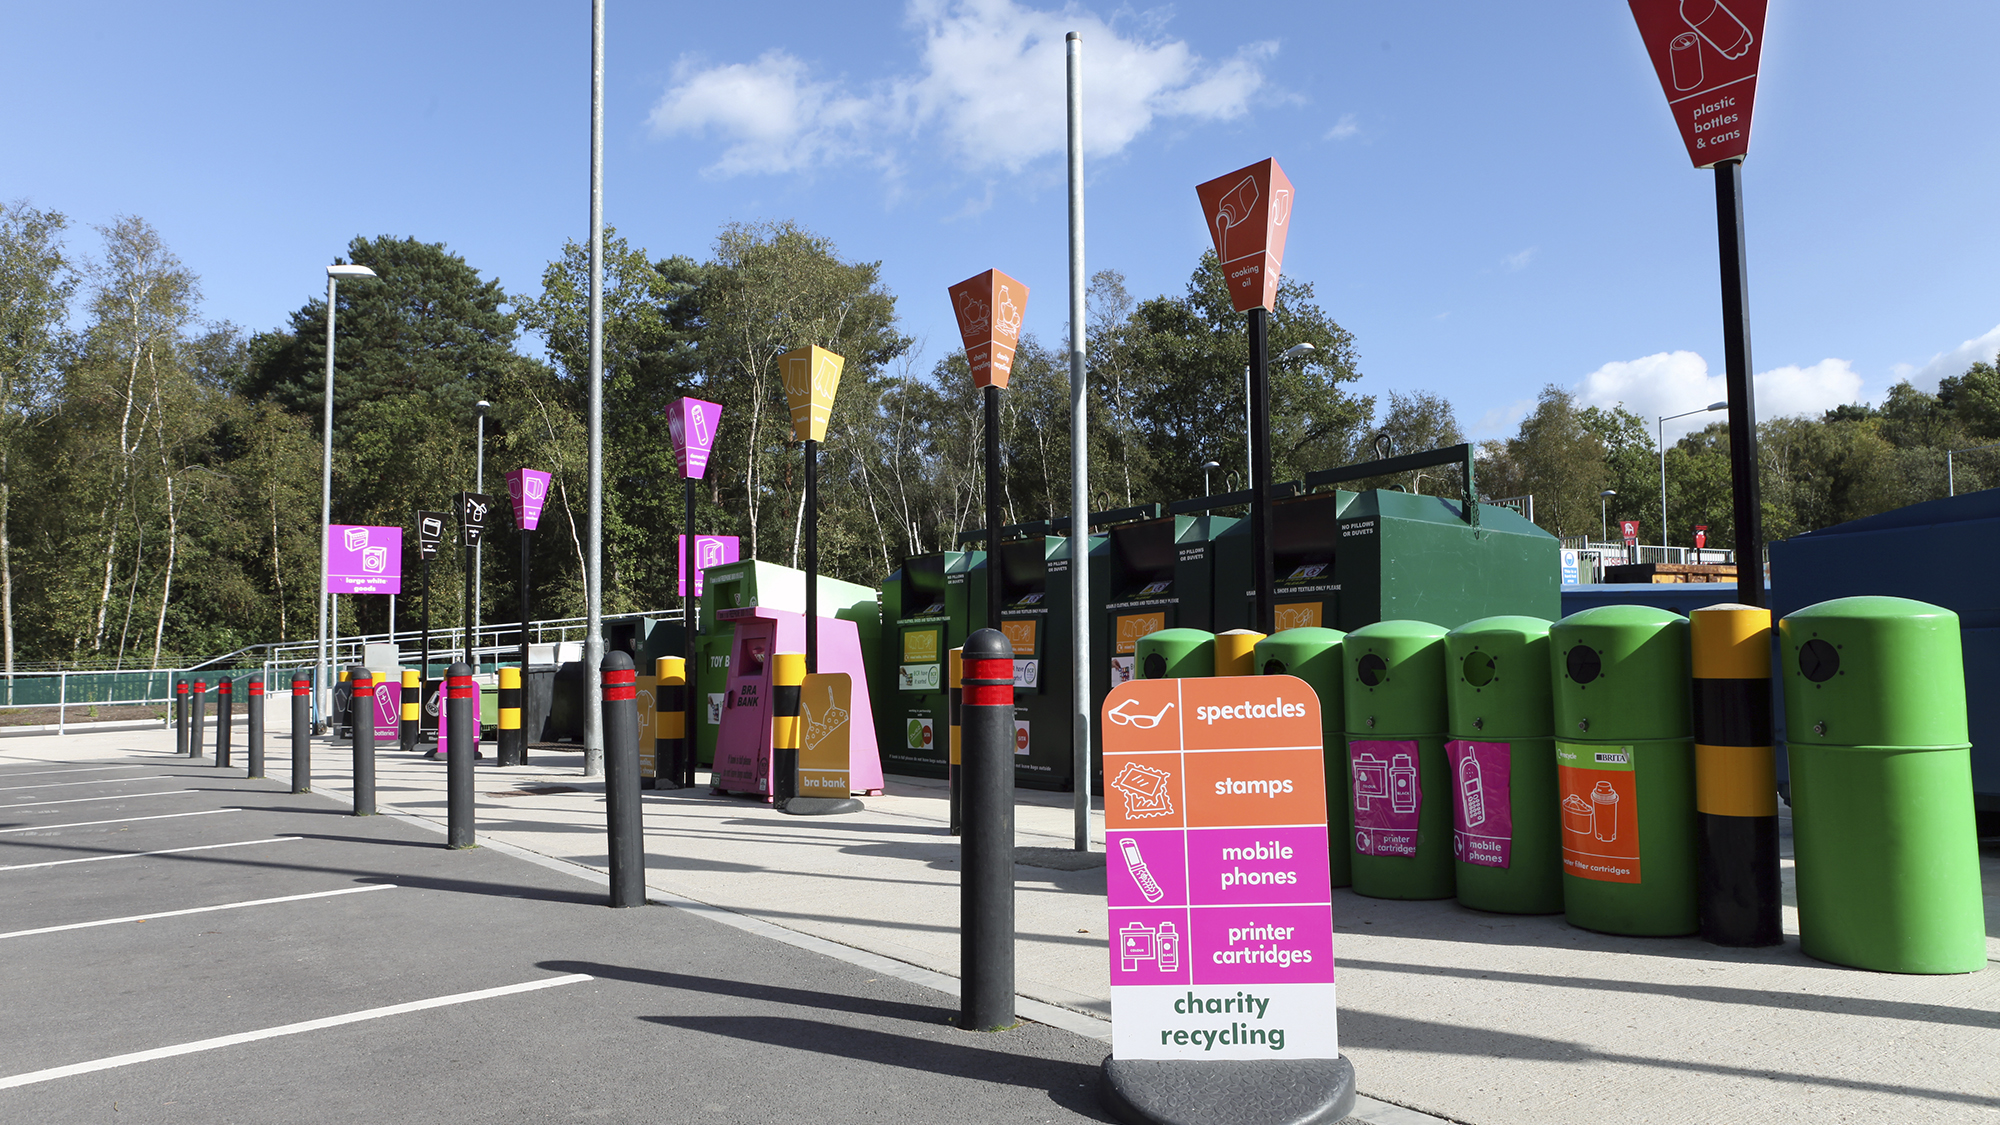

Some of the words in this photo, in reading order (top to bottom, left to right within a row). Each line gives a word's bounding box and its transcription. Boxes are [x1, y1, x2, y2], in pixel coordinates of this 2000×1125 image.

[1693, 96, 1736, 120] plastic
[1694, 113, 1739, 134] bottles
[1696, 137, 1706, 149] &
[1710, 129, 1741, 146] cans
[1231, 264, 1260, 280] cooking
[1241, 277, 1252, 288] oil
[973, 351, 988, 363] charity
[972, 360, 991, 372] recycling
[1350, 520, 1374, 530] PILLOWS
[1352, 528, 1374, 536] DUVETS
[345, 576, 366, 585] large
[710, 656, 724, 668] TOY
[741, 685, 757, 695] BRA
[737, 697, 759, 707] BANK
[1196, 697, 1306, 725] spectacles
[804, 776, 820, 787] bra
[822, 777, 846, 788] bank
[1215, 776, 1294, 798] stamps
[1384, 835, 1410, 843] printer
[1222, 841, 1294, 862] mobile
[1378, 844, 1416, 854] cartridges
[1469, 840, 1502, 852] mobile
[1469, 852, 1503, 863] phones
[1575, 860, 1589, 870] filter
[1590, 862, 1630, 875] cartridges
[1220, 865, 1298, 890] phones
[1228, 922, 1295, 946] printer
[1212, 943, 1313, 968] cartridges
[1173, 991, 1271, 1020] charity
[1160, 1022, 1286, 1051] recycling
